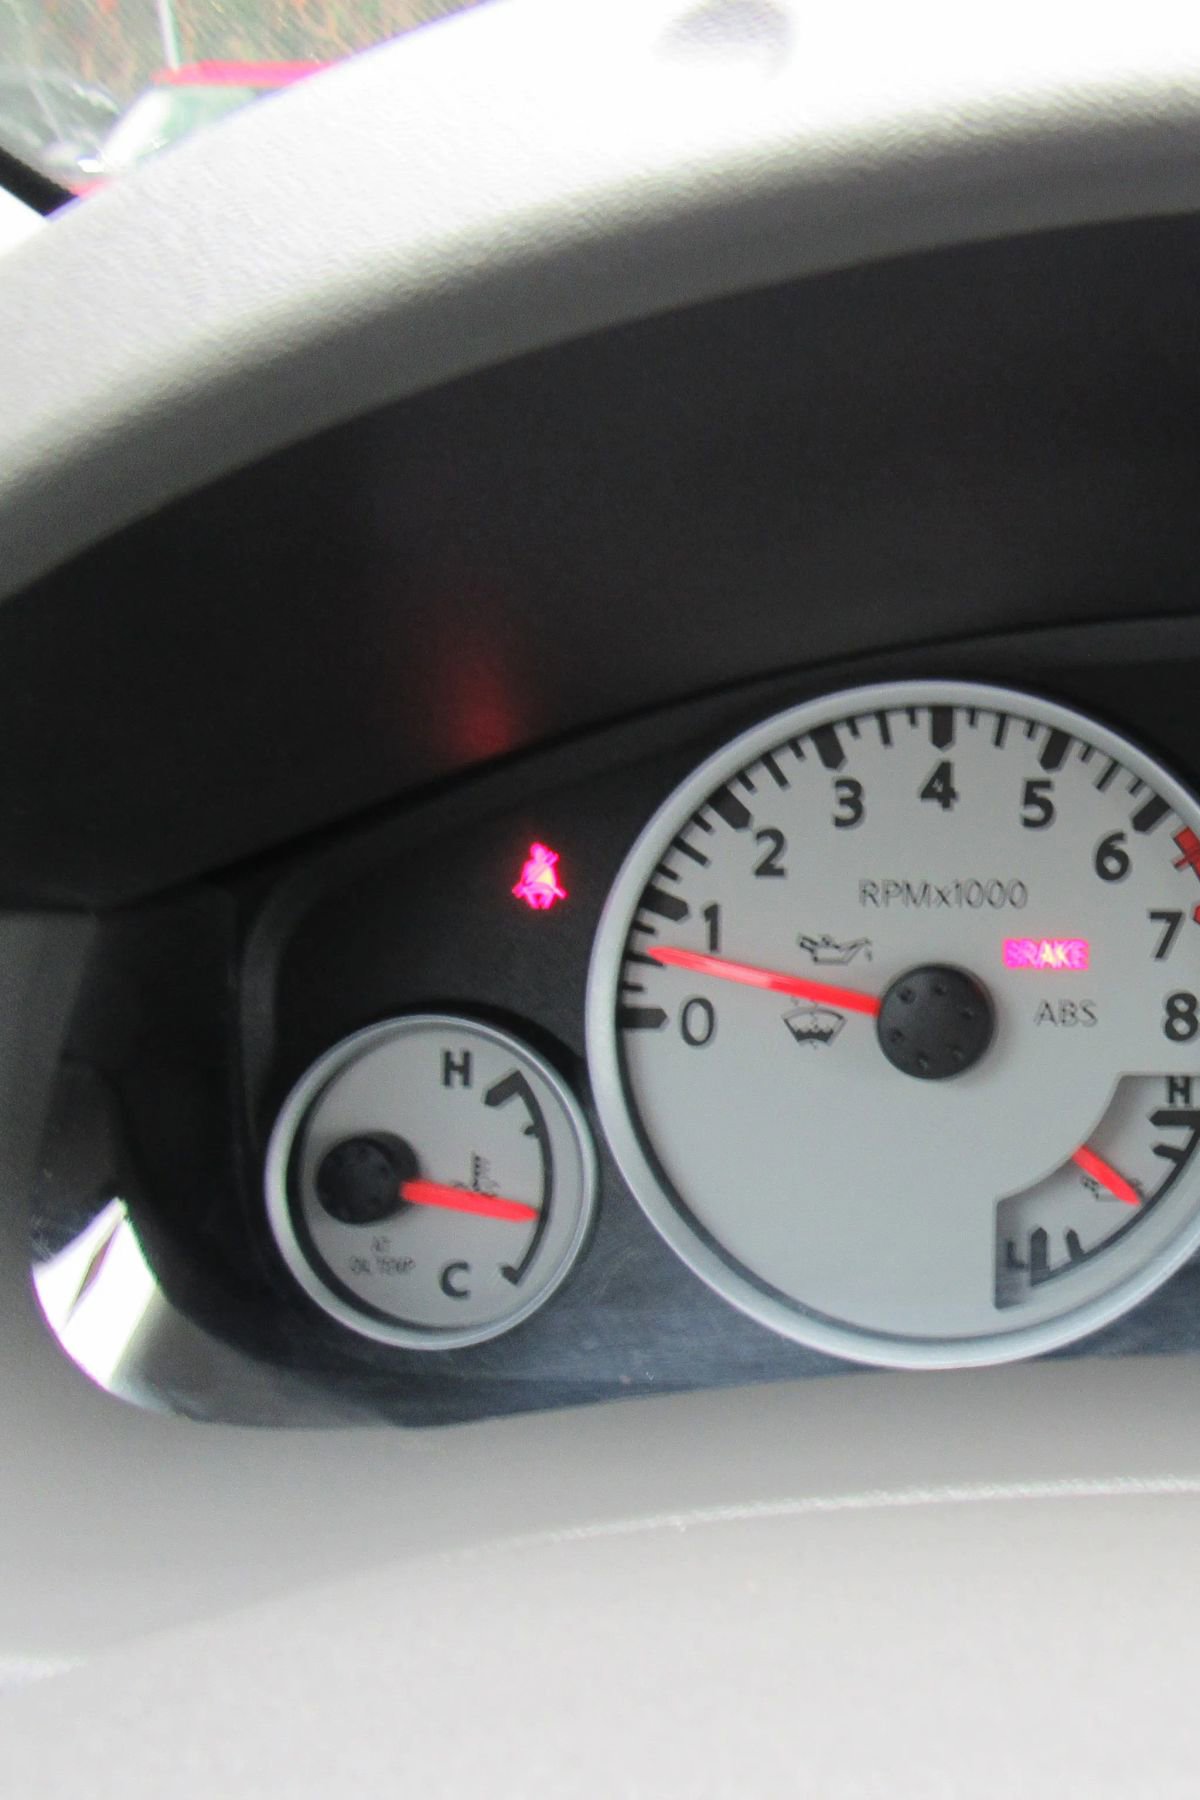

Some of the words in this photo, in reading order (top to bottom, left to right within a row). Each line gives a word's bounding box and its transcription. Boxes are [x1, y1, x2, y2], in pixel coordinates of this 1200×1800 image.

[833, 779, 865, 829] 3
[920, 762, 957, 810] 4
[1021, 779, 1056, 829] 5
[753, 829, 788, 878] 2
[1096, 832, 1130, 882] 6
[858, 879, 1029, 911] RPMx1000
[703, 904, 721, 952] 1
[1150, 910, 1184, 960] 7
[1002, 937, 1089, 970] BRAKE
[680, 998, 717, 1047] 0
[1034, 1001, 1098, 1028] ABS
[1163, 993, 1200, 1043] 8
[442, 1051, 473, 1088] H
[1167, 1077, 1192, 1106] H
[440, 1261, 472, 1299] C
